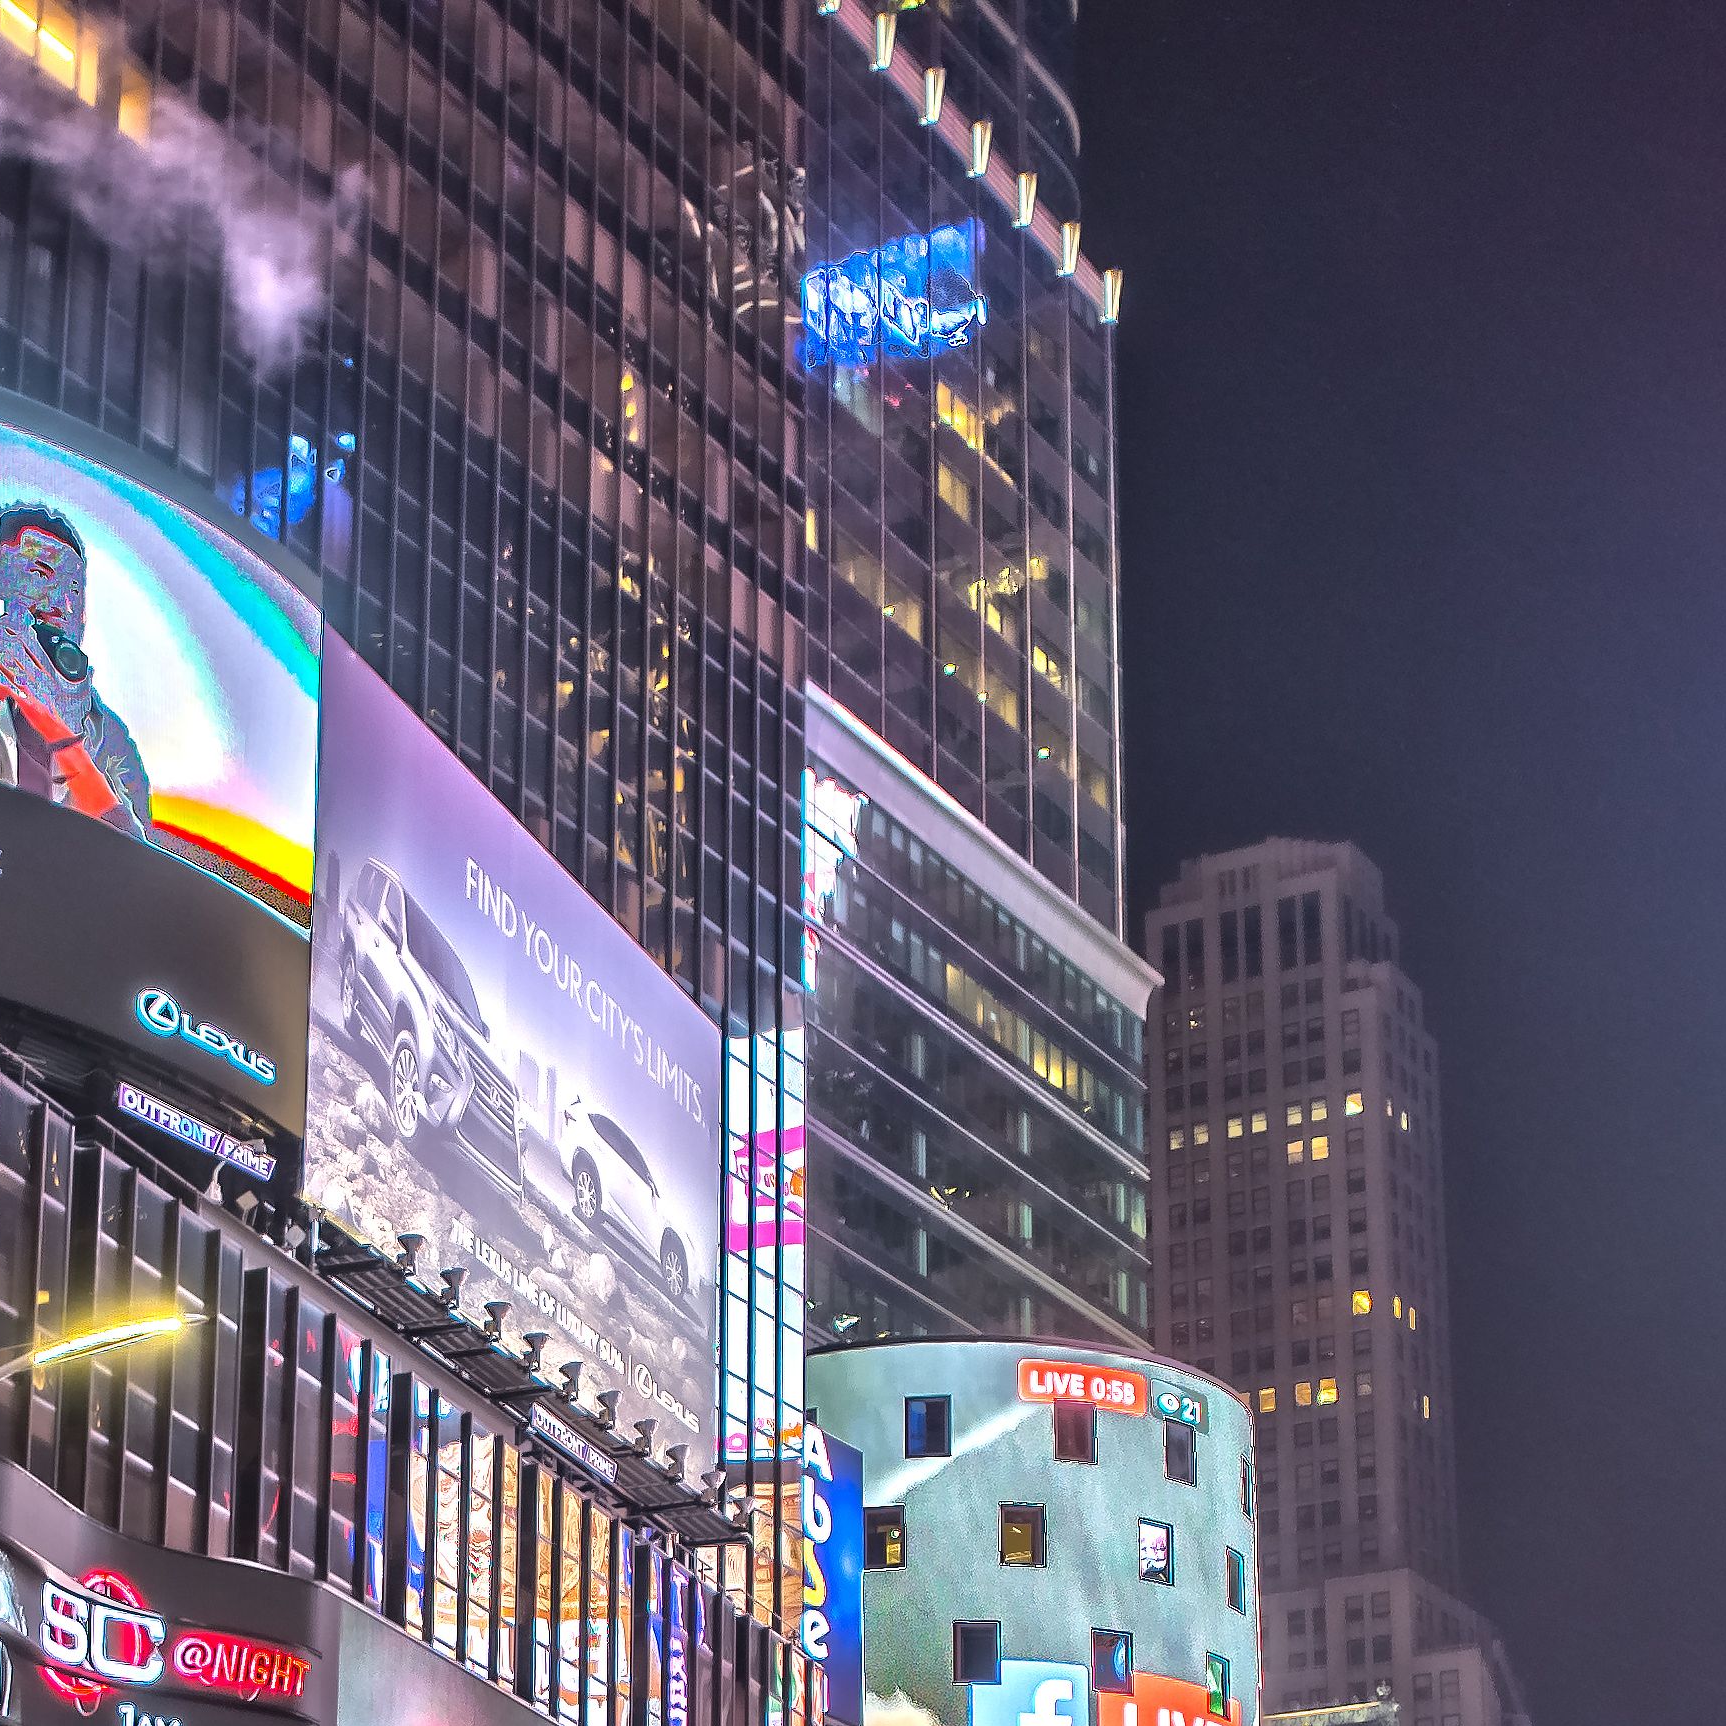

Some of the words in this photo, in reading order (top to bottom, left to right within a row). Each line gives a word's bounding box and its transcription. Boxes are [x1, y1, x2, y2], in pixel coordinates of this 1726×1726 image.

[464, 856, 518, 938] FIND
[521, 910, 583, 1009] YOUR
[585, 979, 645, 1066] CITY'S
[646, 1035, 707, 1128] LIMITS.
[180, 1010, 278, 1087] LEXUS
[223, 1140, 272, 1176] PRIME
[1029, 1368, 1086, 1399] LIVE
[651, 1384, 701, 1435] LEXUS
[1181, 1396, 1202, 1424] 21
[39, 1576, 167, 1686] SC
[173, 1634, 312, 1699] @NIGHT
